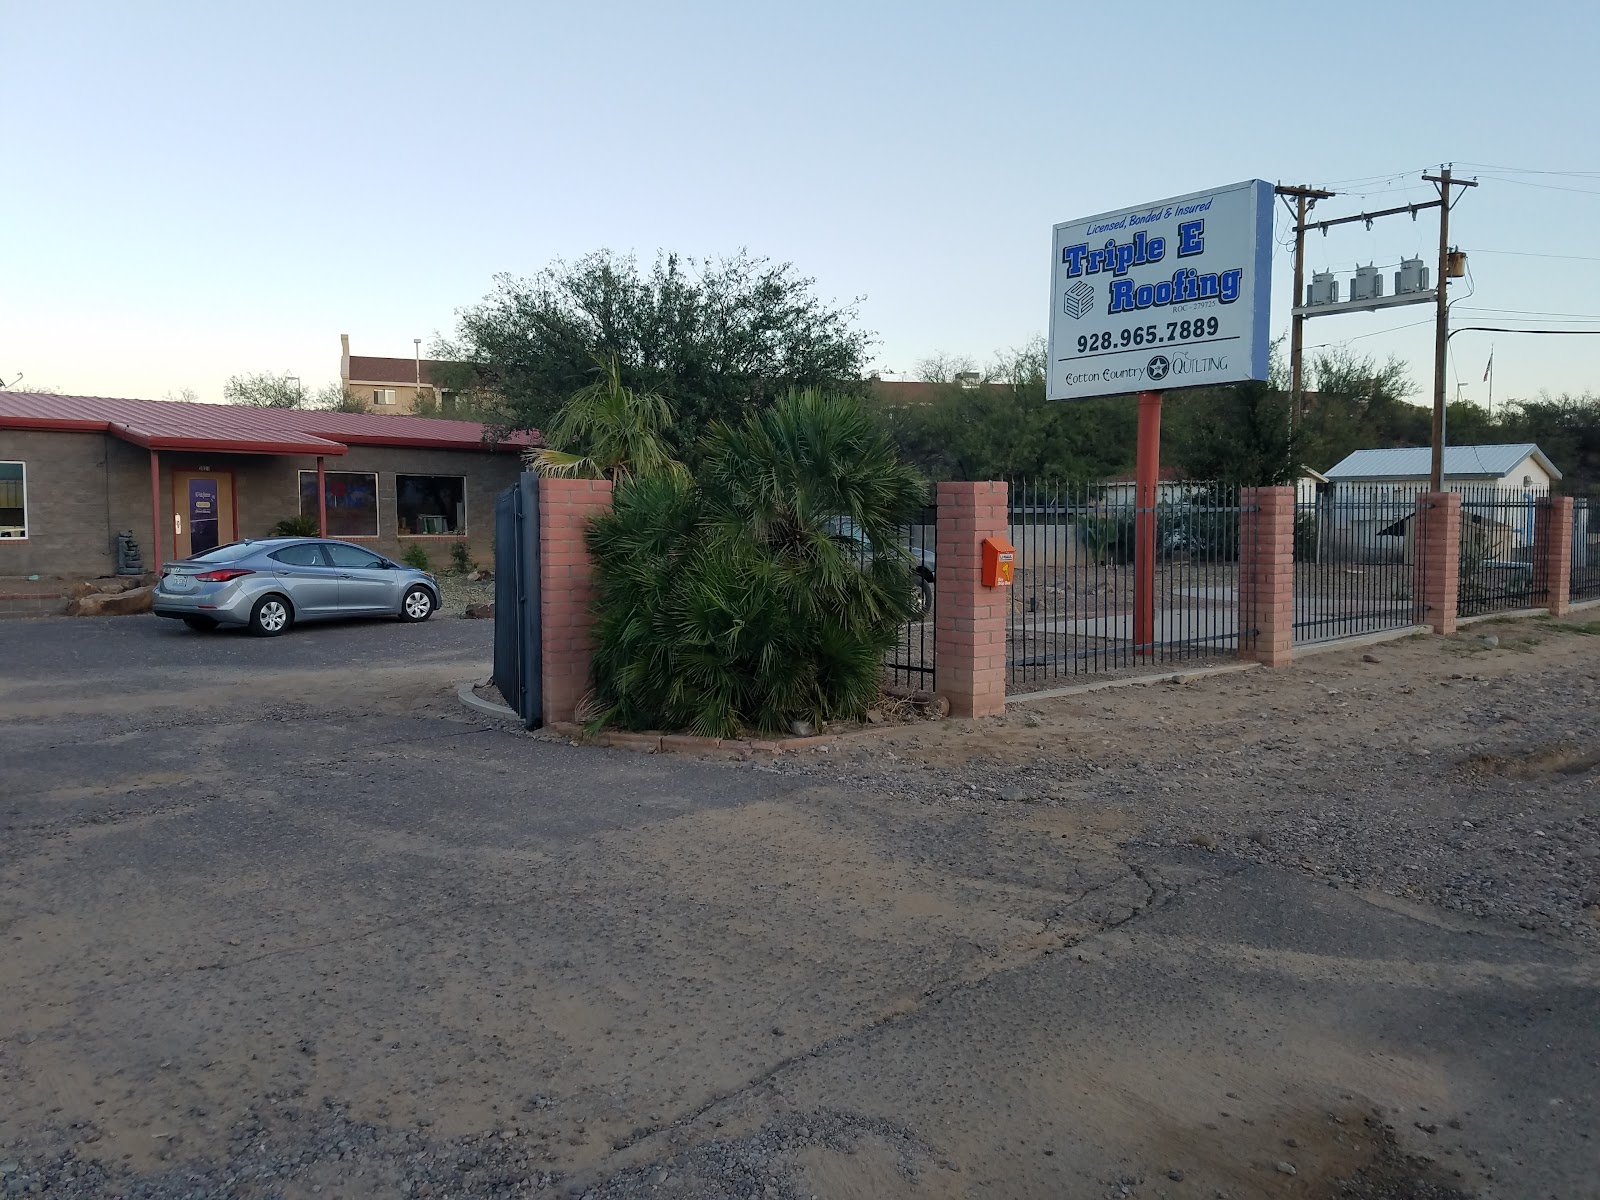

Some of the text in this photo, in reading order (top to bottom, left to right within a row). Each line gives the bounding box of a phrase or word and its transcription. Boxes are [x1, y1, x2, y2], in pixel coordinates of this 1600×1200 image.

[1086, 198, 1213, 236] Licensed, Bonded & Insured
[1062, 218, 1204, 279] Triple E
[1107, 268, 1242, 315] Roofing
[1172, 305, 1188, 313] ROC
[1077, 316, 1219, 353] 928.965.7889
[1066, 355, 1228, 386] Cotton Country QUILTING
